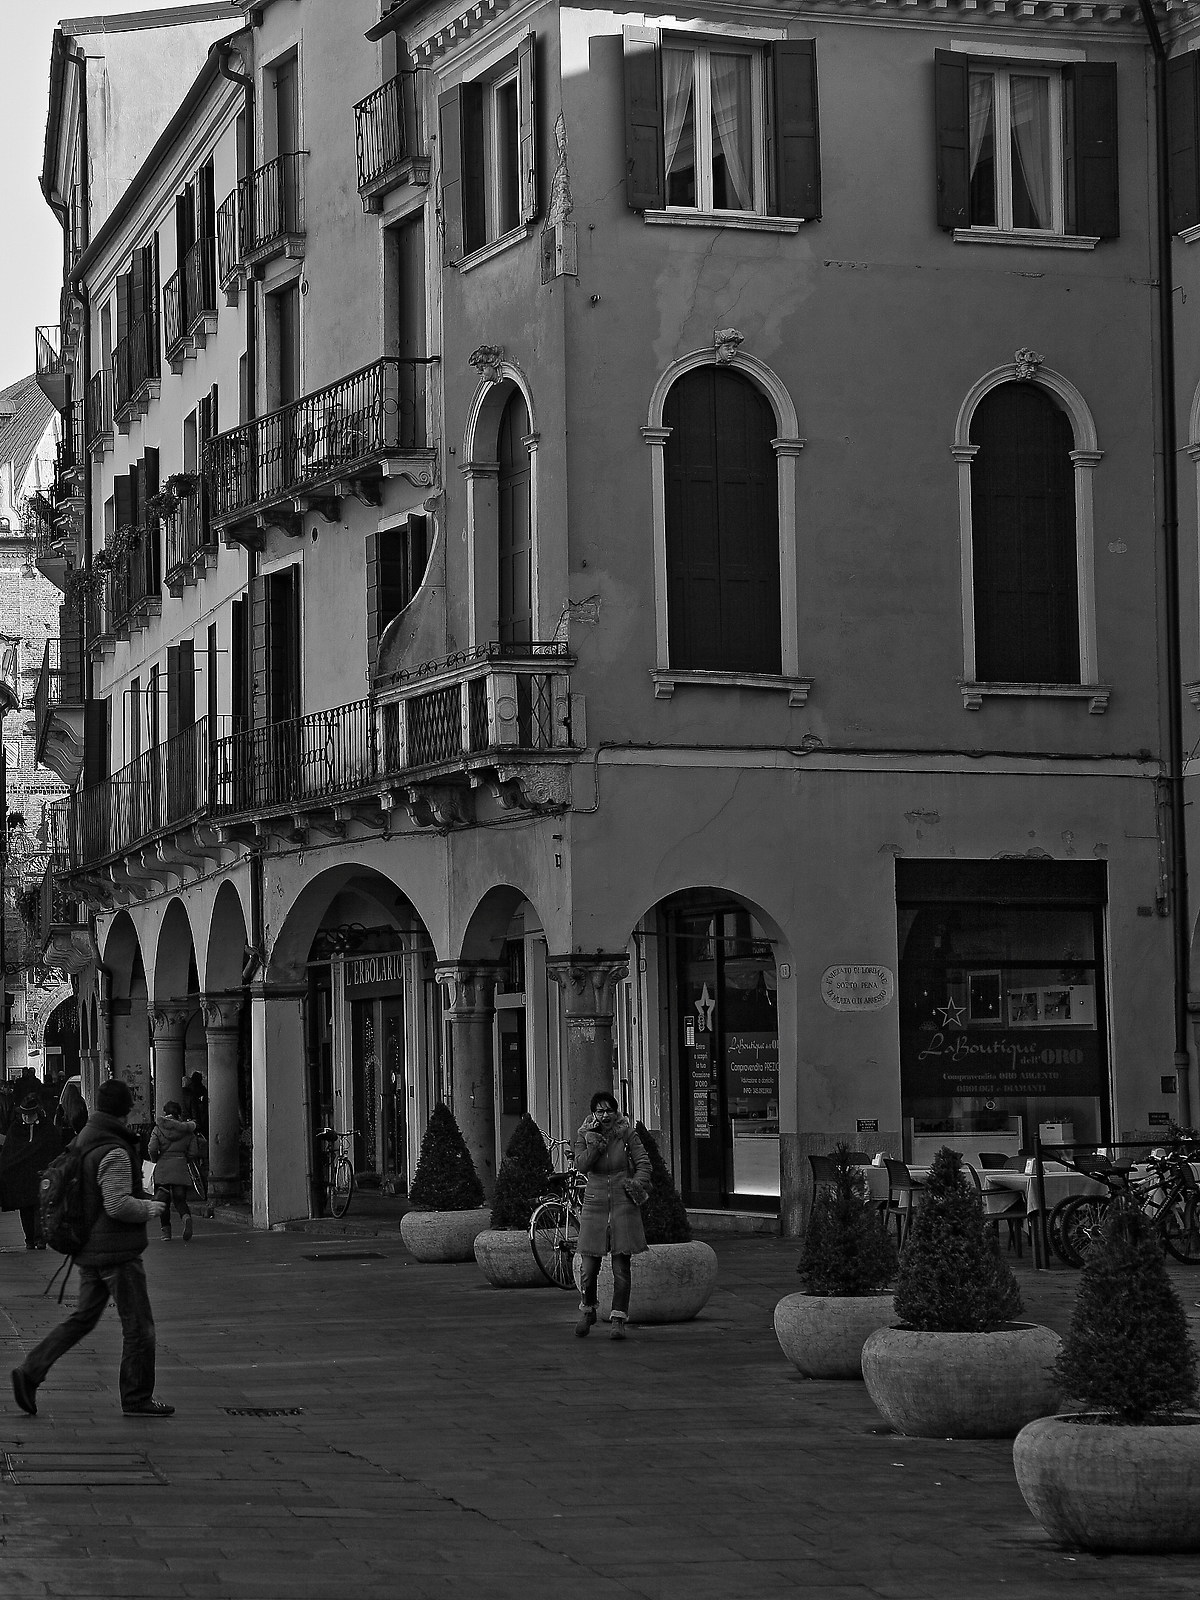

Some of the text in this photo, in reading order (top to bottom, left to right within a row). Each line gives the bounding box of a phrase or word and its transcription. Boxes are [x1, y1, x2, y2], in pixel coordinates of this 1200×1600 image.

[346, 955, 402, 986] L'ERBOLARIO
[836, 981, 878, 990] SOTTO PENA
[943, 1072, 1059, 1081] Compravendita ORO ARGENTO
